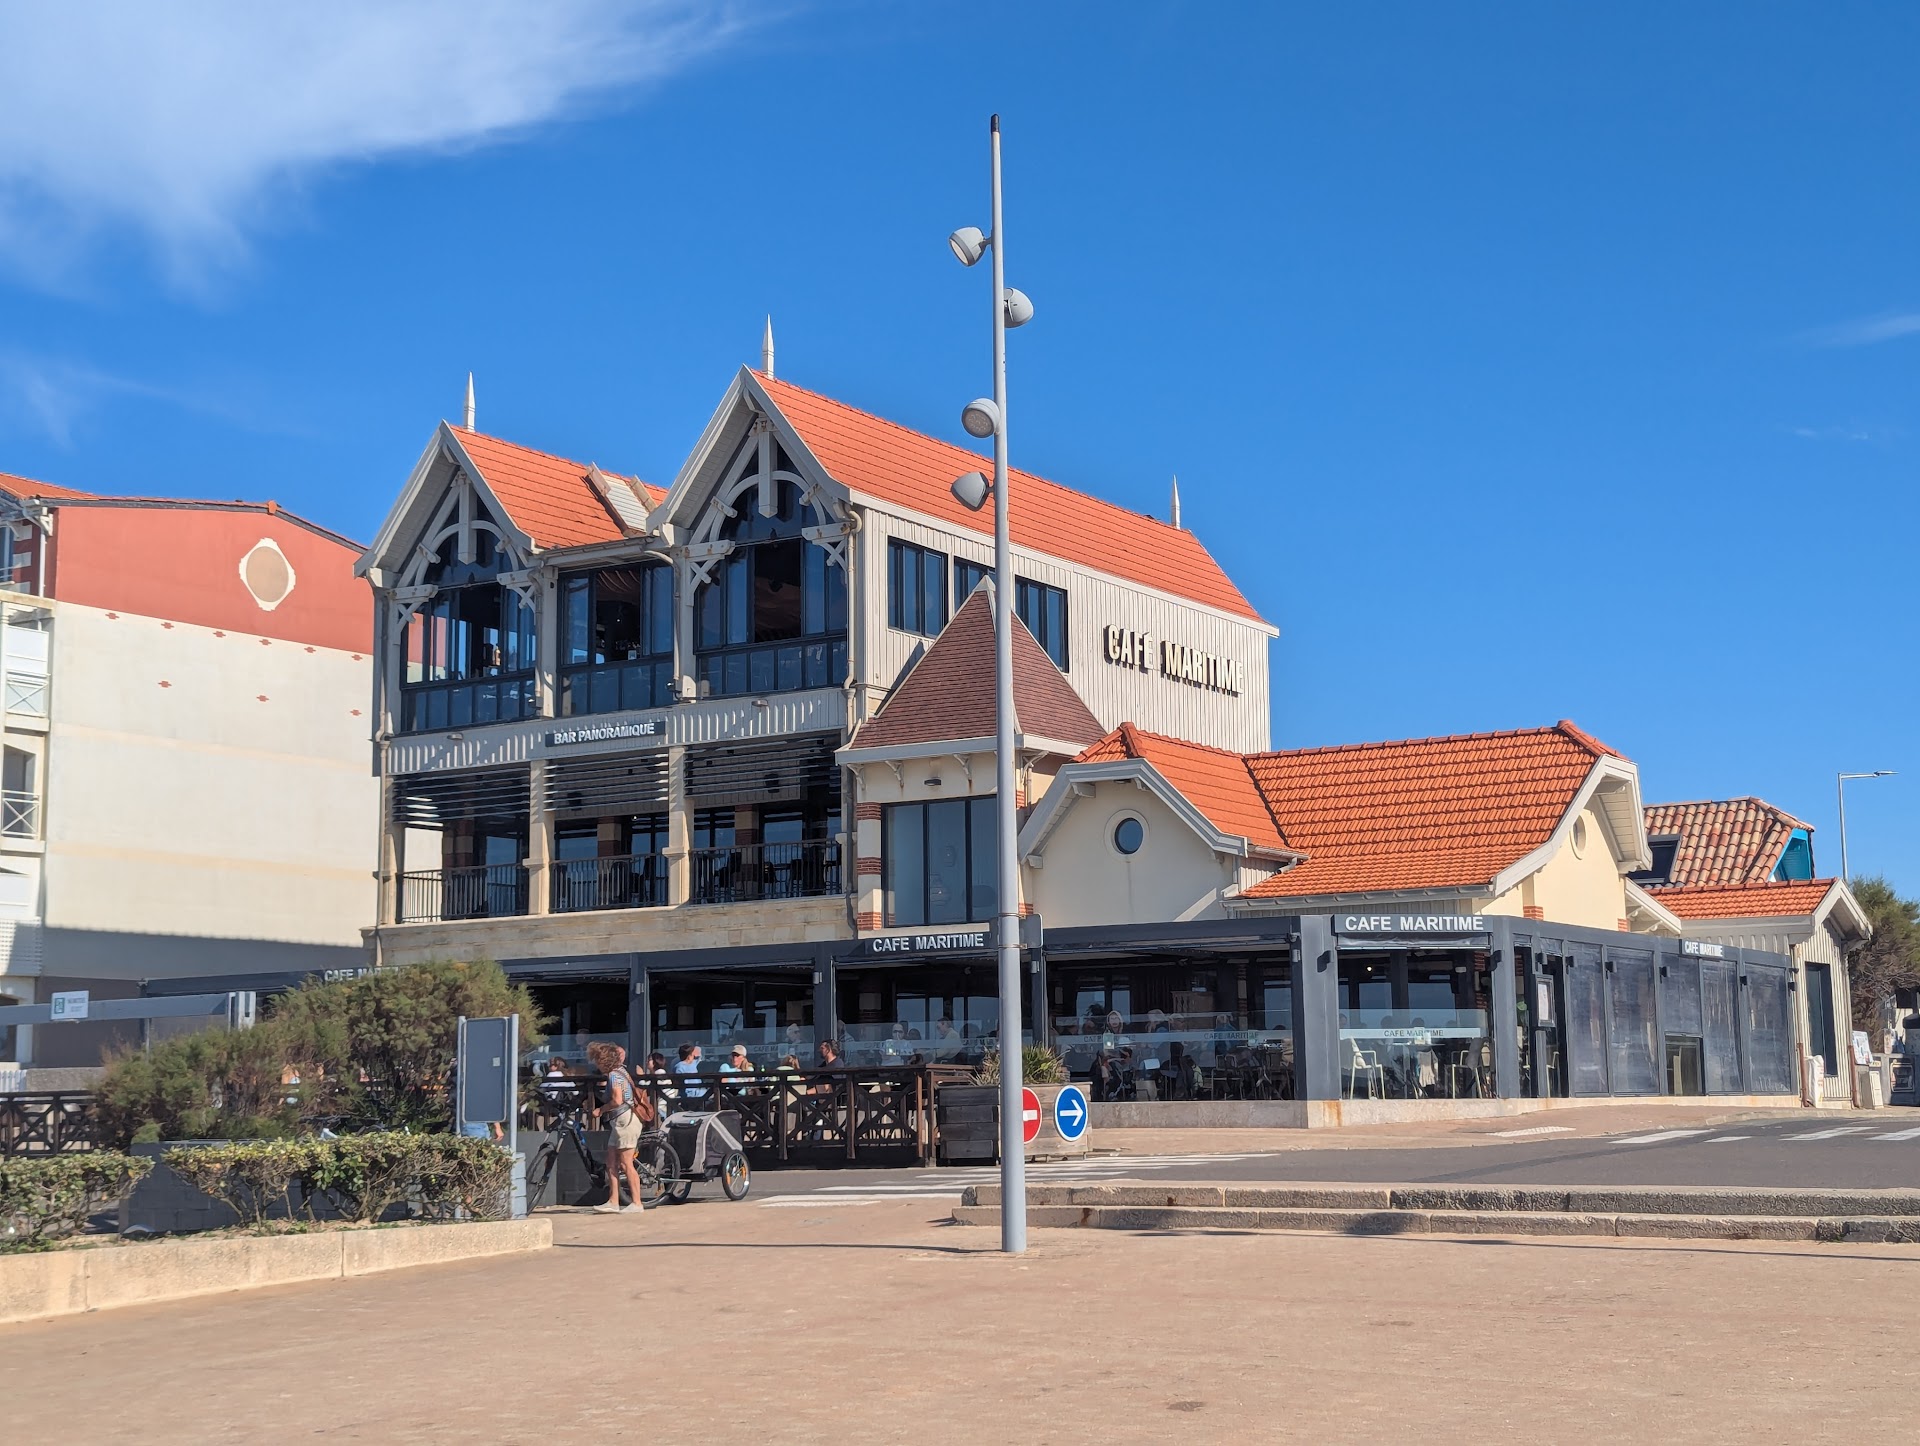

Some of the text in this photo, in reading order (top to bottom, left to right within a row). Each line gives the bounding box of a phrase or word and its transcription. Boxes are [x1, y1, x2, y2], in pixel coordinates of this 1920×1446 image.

[1161, 640, 1244, 695] MARITIME
[554, 723, 655, 744] BAR PANORAMIQUE
[1345, 916, 1484, 931] CAFE MARITIME
[872, 933, 984, 952] CAFE MARITIME
[1684, 940, 1699, 954] CAFE
[324, 968, 354, 981] CAFE
[1384, 1029, 1404, 1037] CAFE
